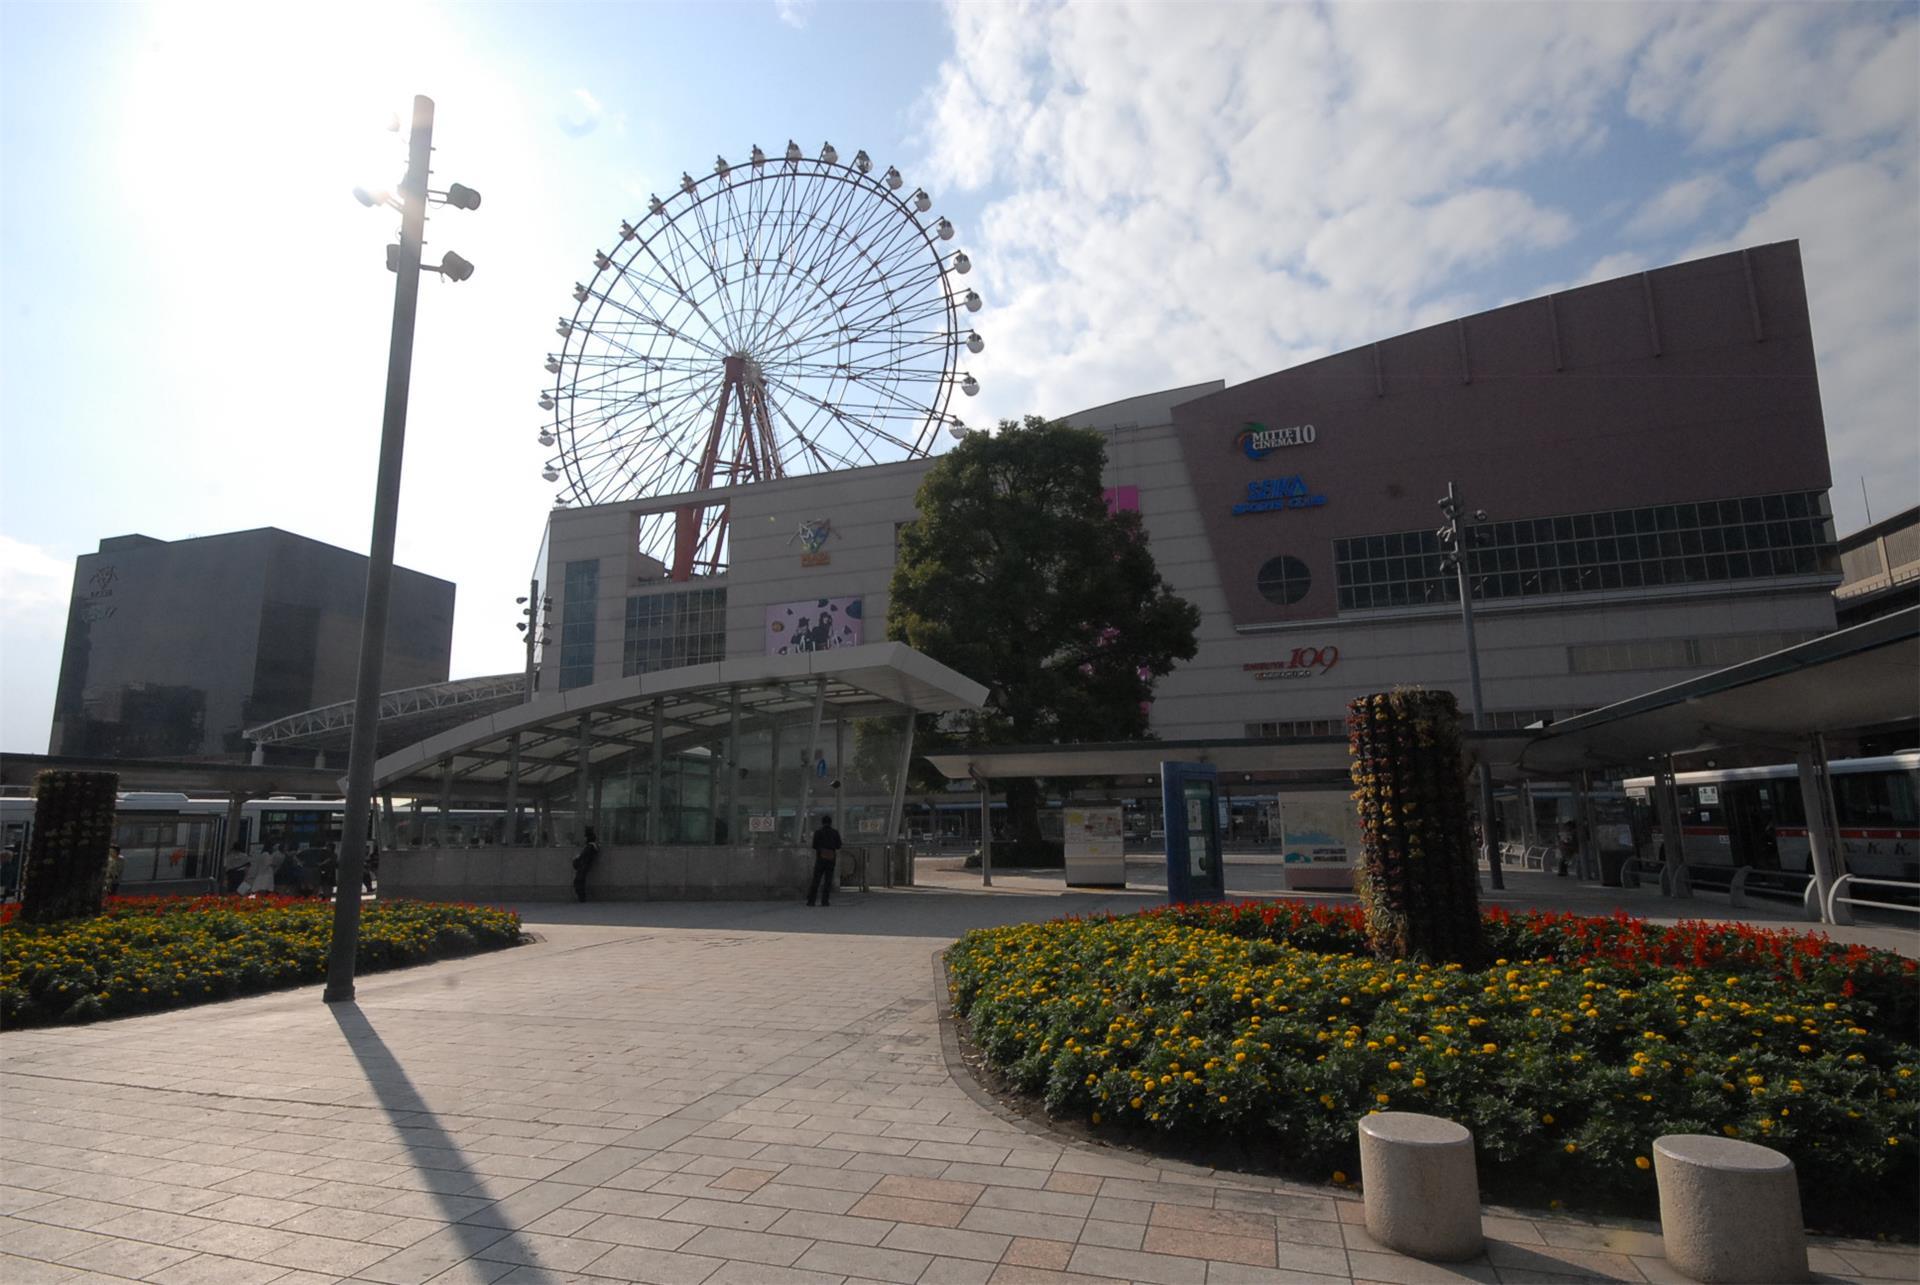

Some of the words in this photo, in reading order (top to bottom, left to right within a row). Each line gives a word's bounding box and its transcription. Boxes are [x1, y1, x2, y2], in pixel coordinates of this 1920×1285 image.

[1252, 428, 1293, 442] MITTE
[1294, 424, 1316, 444] 10
[1252, 438, 1294, 449] CINEMA
[1287, 646, 1338, 675] 109
